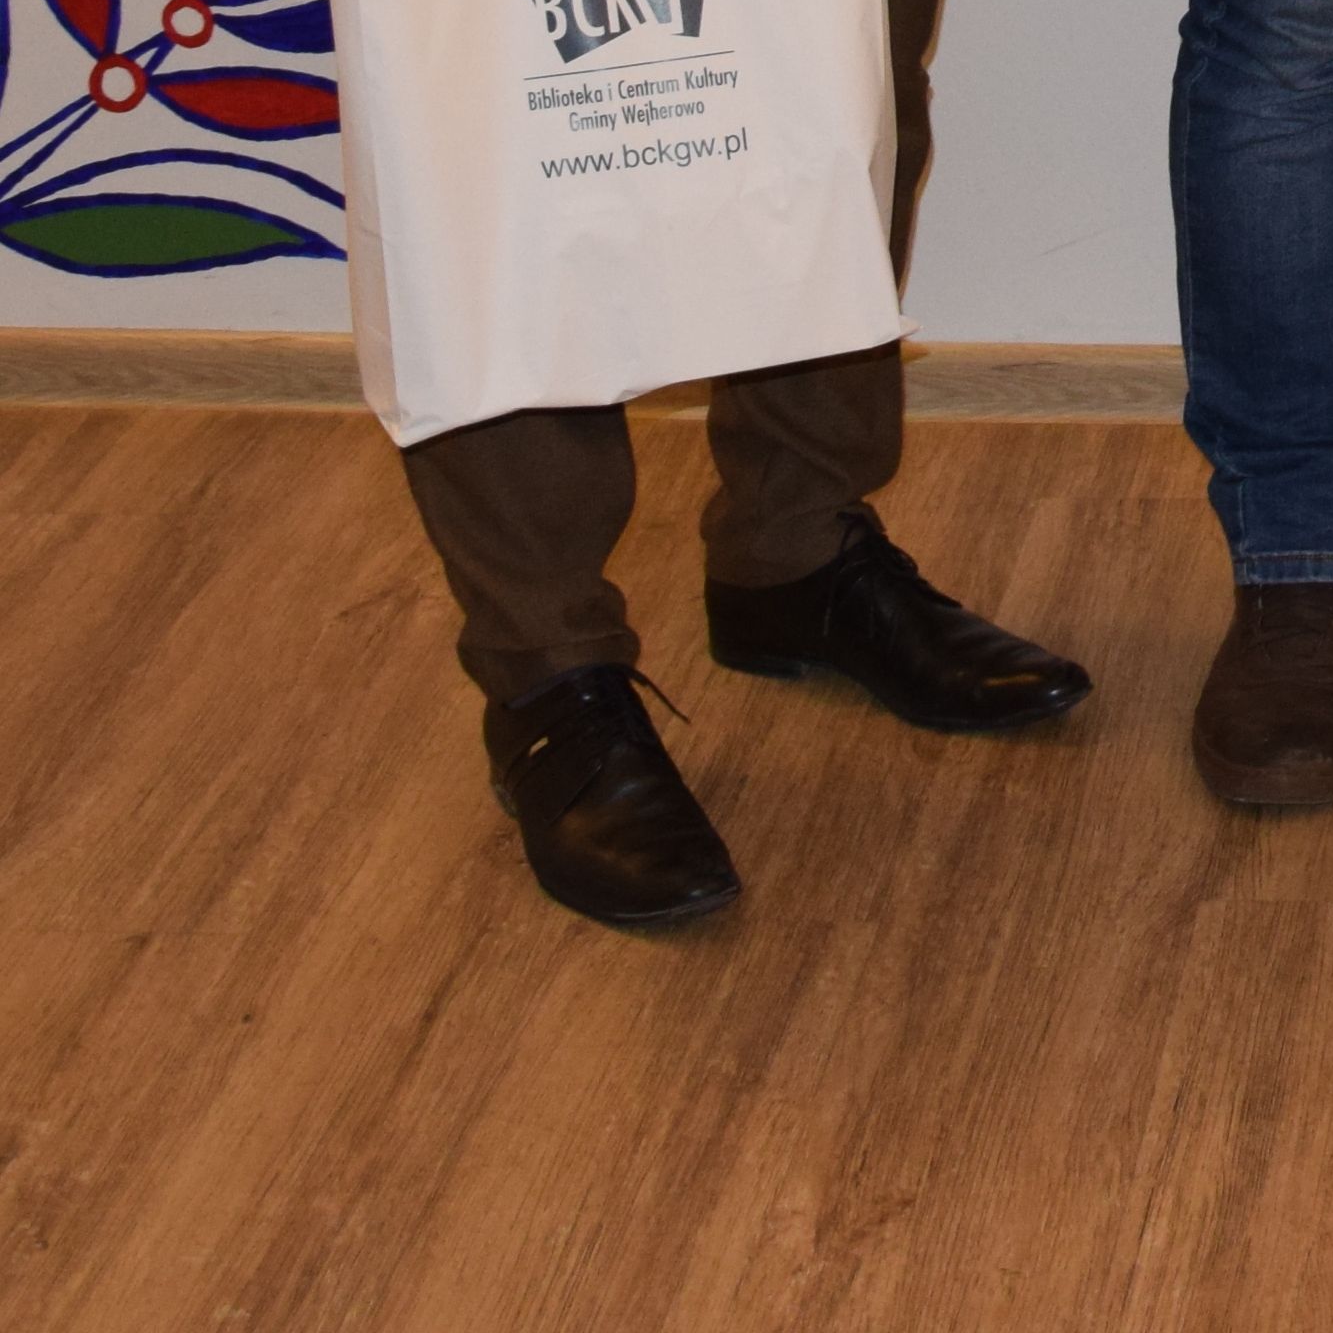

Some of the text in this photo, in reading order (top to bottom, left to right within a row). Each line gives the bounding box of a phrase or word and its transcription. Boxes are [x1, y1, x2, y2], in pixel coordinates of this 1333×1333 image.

[528, 66, 738, 112] Biblioteka i Centrum Kultury
[568, 99, 705, 133] Gminy Wejherowo
[540, 126, 748, 179] www.bckgw.pl
